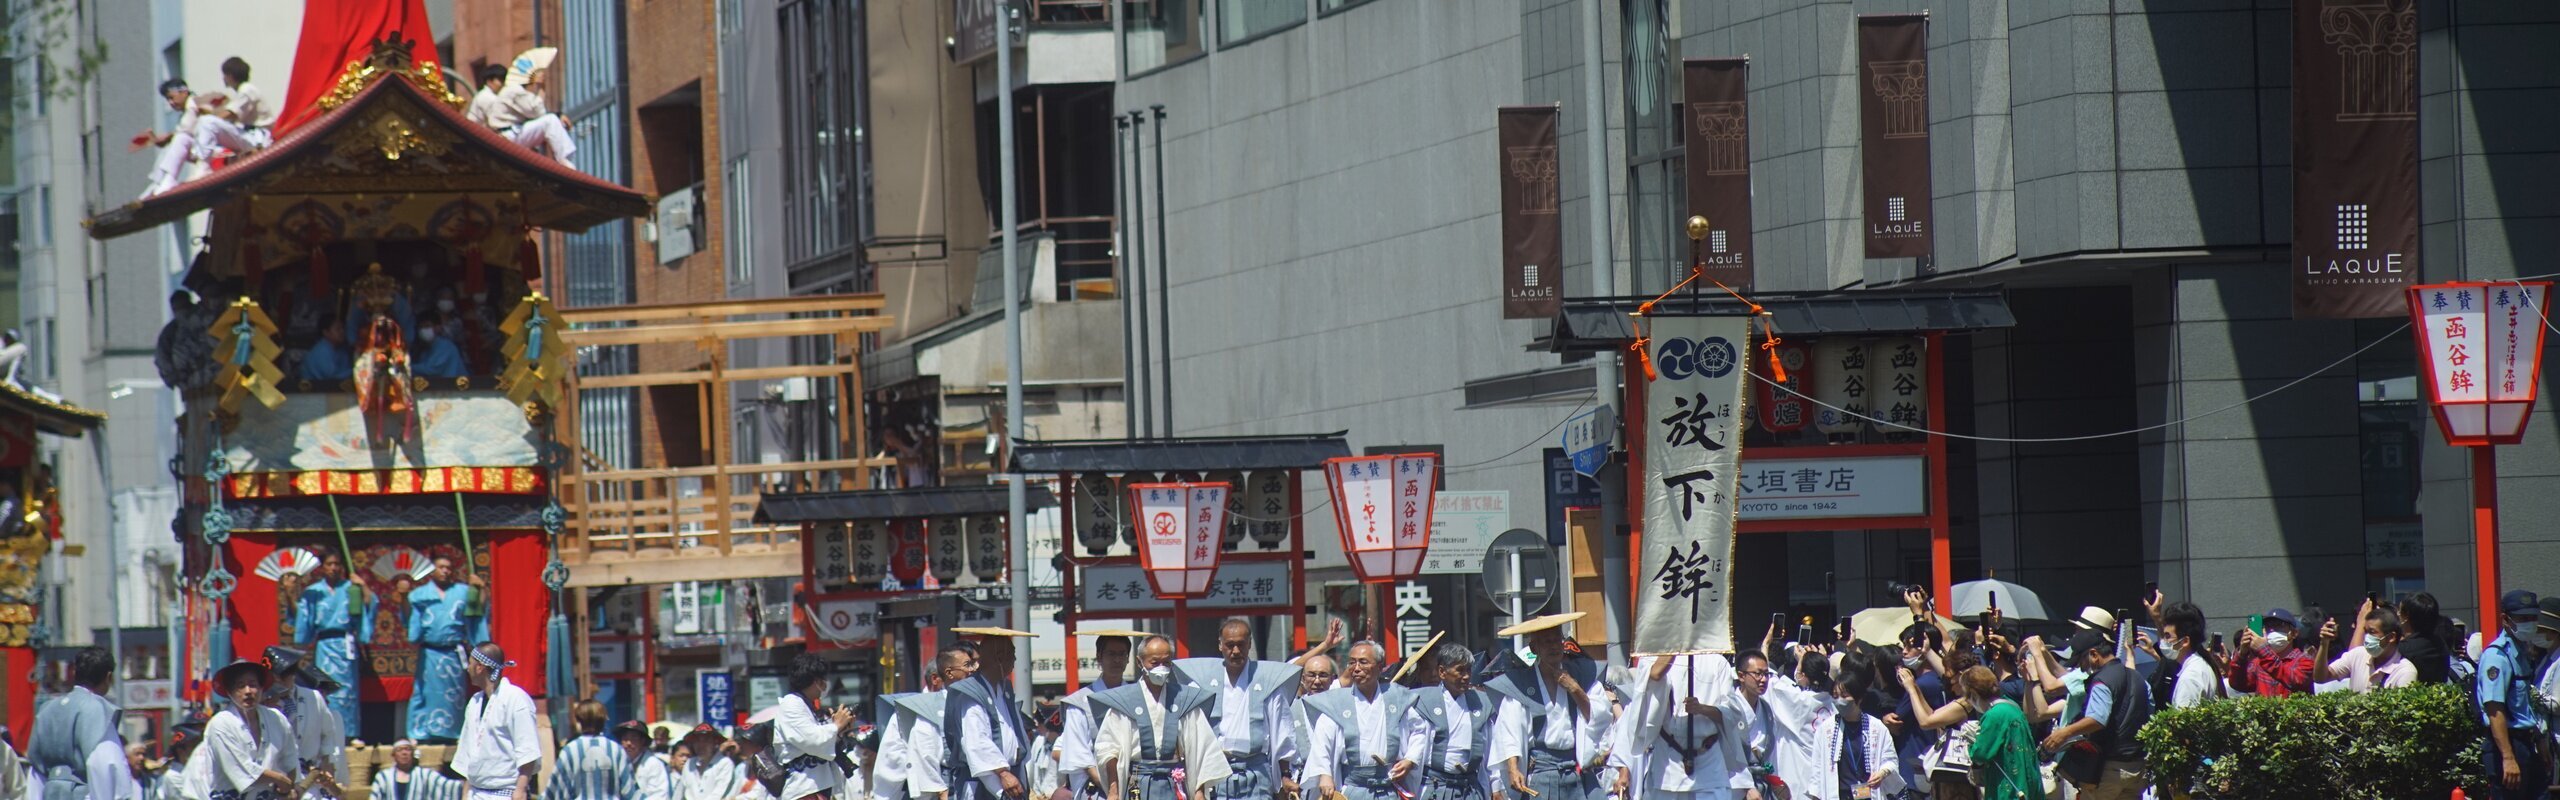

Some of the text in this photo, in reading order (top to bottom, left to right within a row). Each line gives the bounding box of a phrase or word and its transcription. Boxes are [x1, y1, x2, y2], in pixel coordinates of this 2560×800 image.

[1874, 221, 1922, 234] LAQUE
[1700, 253, 1743, 265] AQUE
[2308, 253, 2402, 275] LAQUE
[1511, 287, 1553, 298] LAQUE
[2445, 316, 2474, 394] 函谷鉾
[1841, 346, 1866, 427] 函谷鉾
[1890, 343, 1919, 425] 函谷鉾
[1717, 404, 1731, 443] ほう
[1090, 478, 1113, 540] 函谷鉾
[1262, 475, 1283, 536] 函谷鉾
[1401, 479, 1419, 542] 函谷鉾
[1652, 392, 1725, 625] 放下鉾
[1713, 492, 1725, 504] か
[1741, 502, 1837, 512] KYOTO since 1942
[1194, 507, 1212, 561] 函谷鉾
